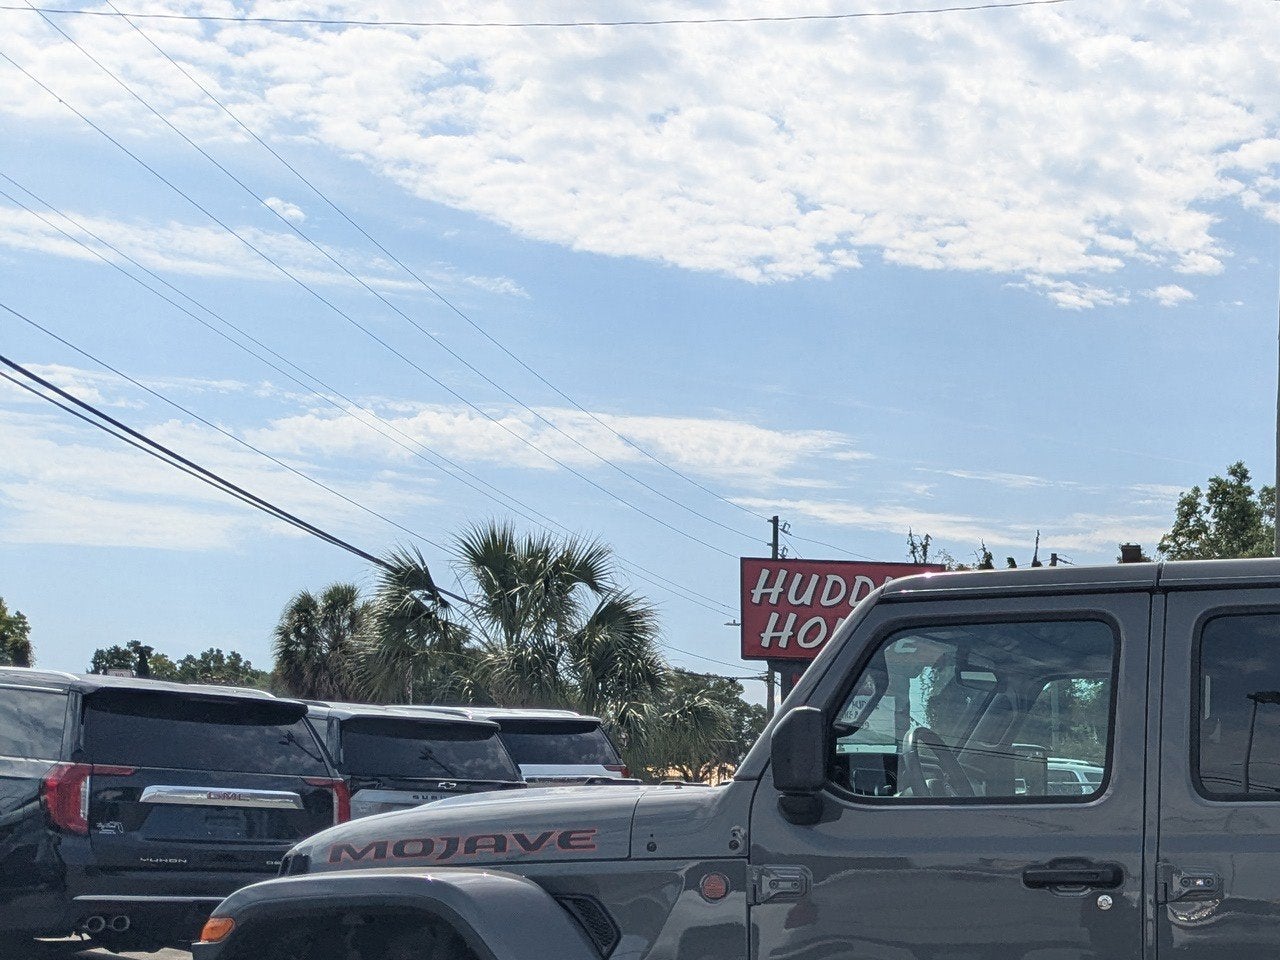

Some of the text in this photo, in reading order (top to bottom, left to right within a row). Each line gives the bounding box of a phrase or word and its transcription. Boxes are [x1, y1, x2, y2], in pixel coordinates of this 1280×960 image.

[750, 568, 894, 608] HUDD
[759, 611, 845, 649] HO
[206, 791, 250, 801] GMC
[328, 828, 597, 863] MOJAVE
